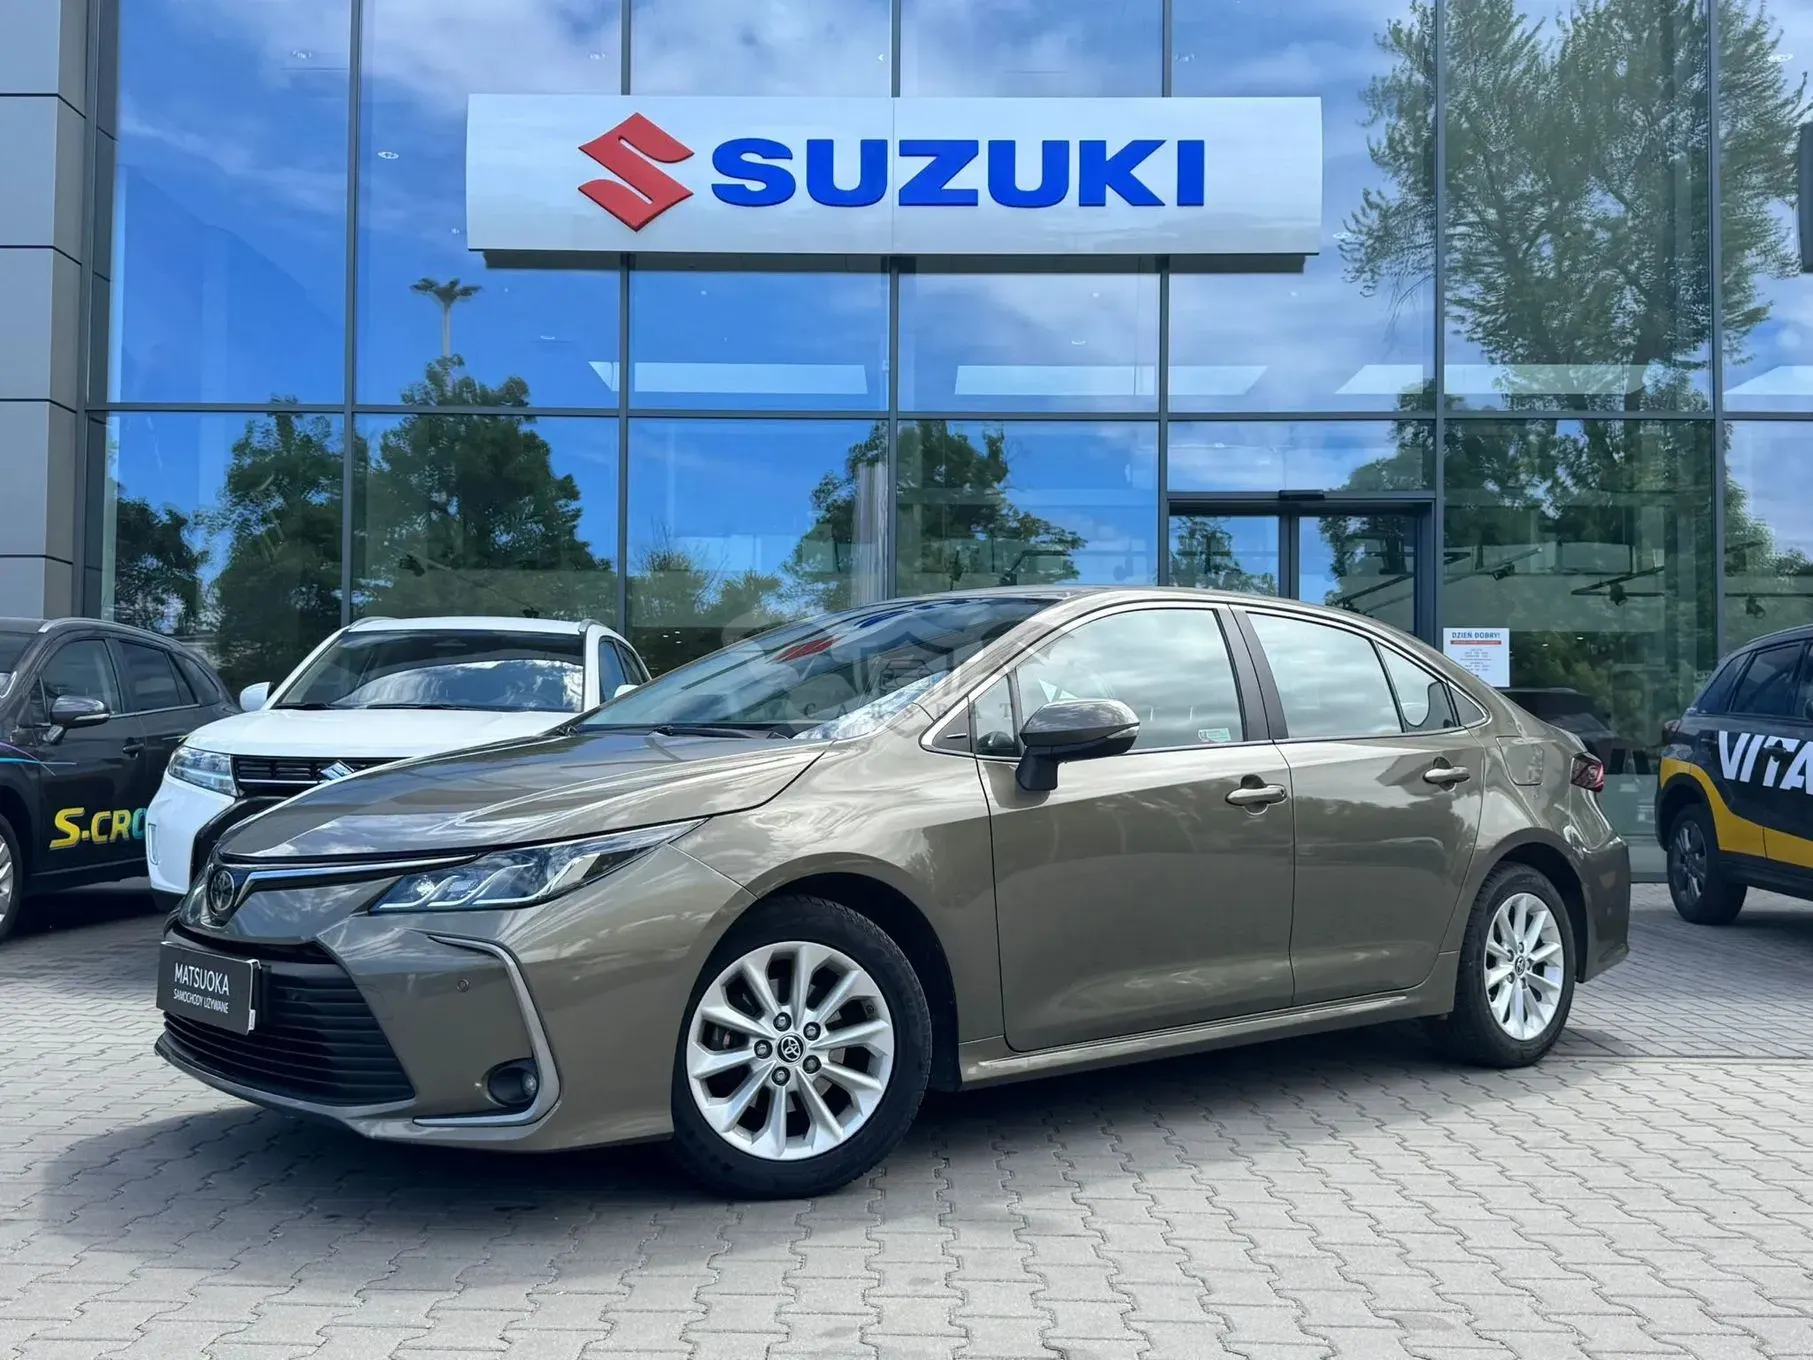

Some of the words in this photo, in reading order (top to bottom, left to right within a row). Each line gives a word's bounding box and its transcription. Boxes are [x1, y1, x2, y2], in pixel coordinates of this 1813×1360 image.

[711, 137, 1205, 208] SUZUKI
[1718, 730, 1813, 796] VITA
[172, 988, 204, 1006] SAMOCHODY
[174, 962, 230, 996] MATSUOKA
